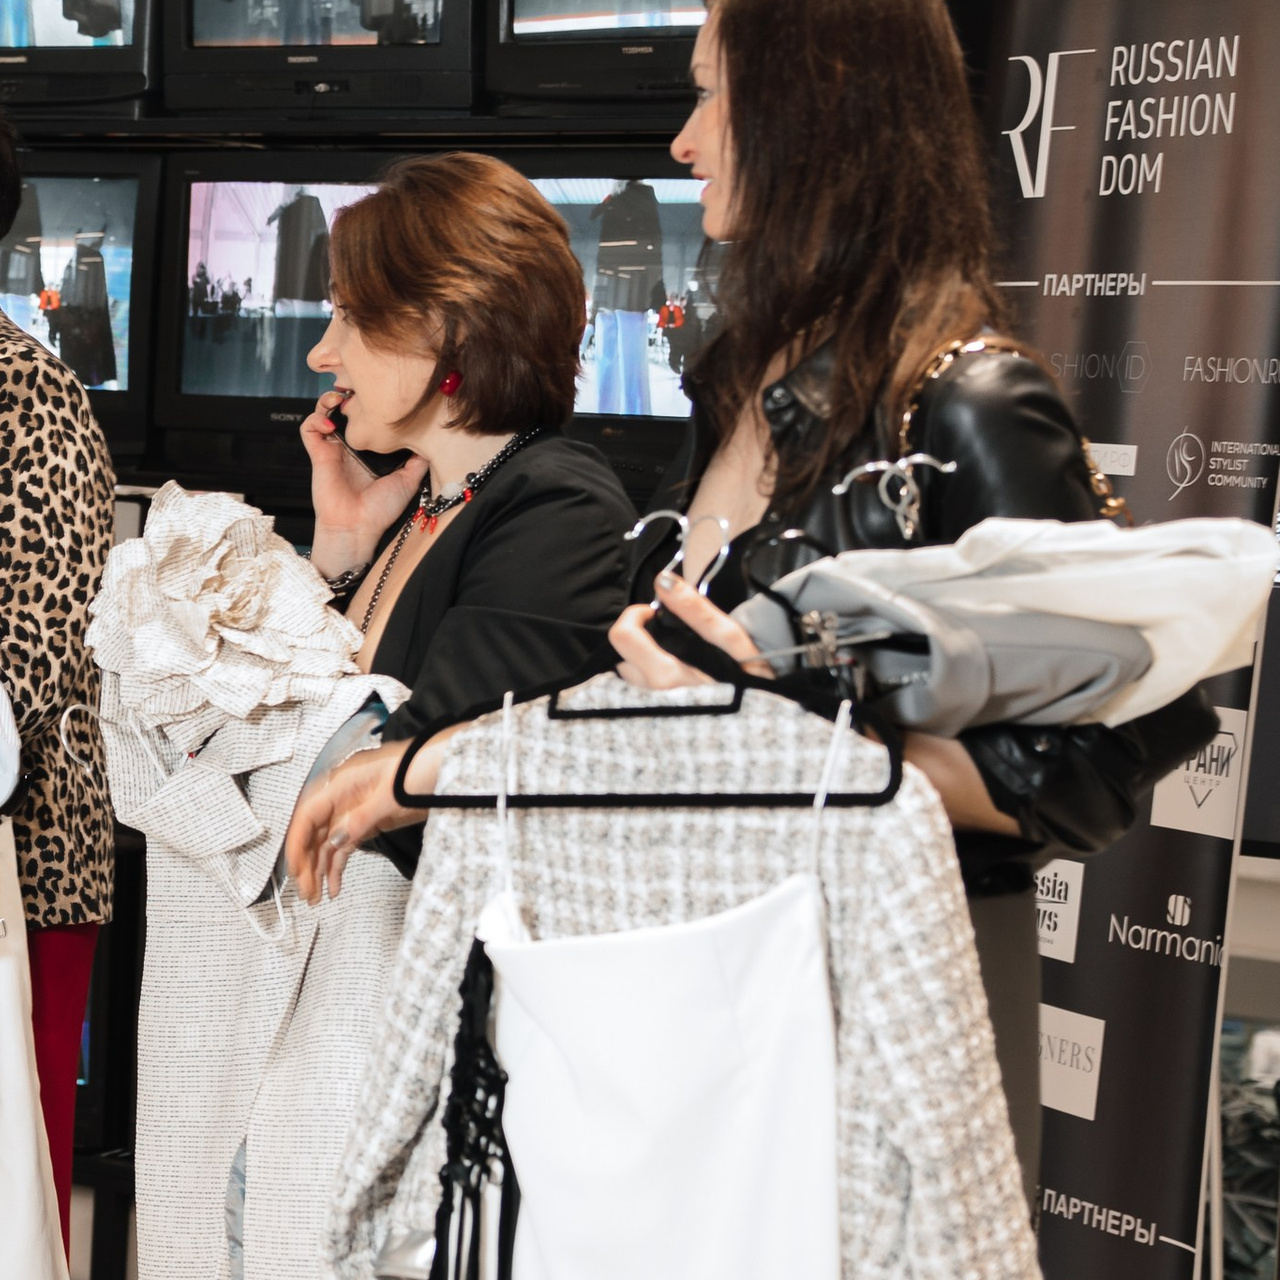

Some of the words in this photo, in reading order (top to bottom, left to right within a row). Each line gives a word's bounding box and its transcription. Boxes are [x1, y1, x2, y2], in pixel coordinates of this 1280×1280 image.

[1110, 35, 1240, 87] RUSSIAN
[1104, 92, 1236, 141] FASHION
[1098, 152, 1163, 196] DOM
[1043, 273, 1147, 296] ПАРТНЕРЫ
[1041, 353, 1116, 379] SHION
[1183, 357, 1280, 384] FASHION.R
[1209, 458, 1249, 471] STYLIST
[1207, 474, 1269, 489] COMMUNITY
[1043, 1188, 1157, 1246] ПАРТНЕРЫ
